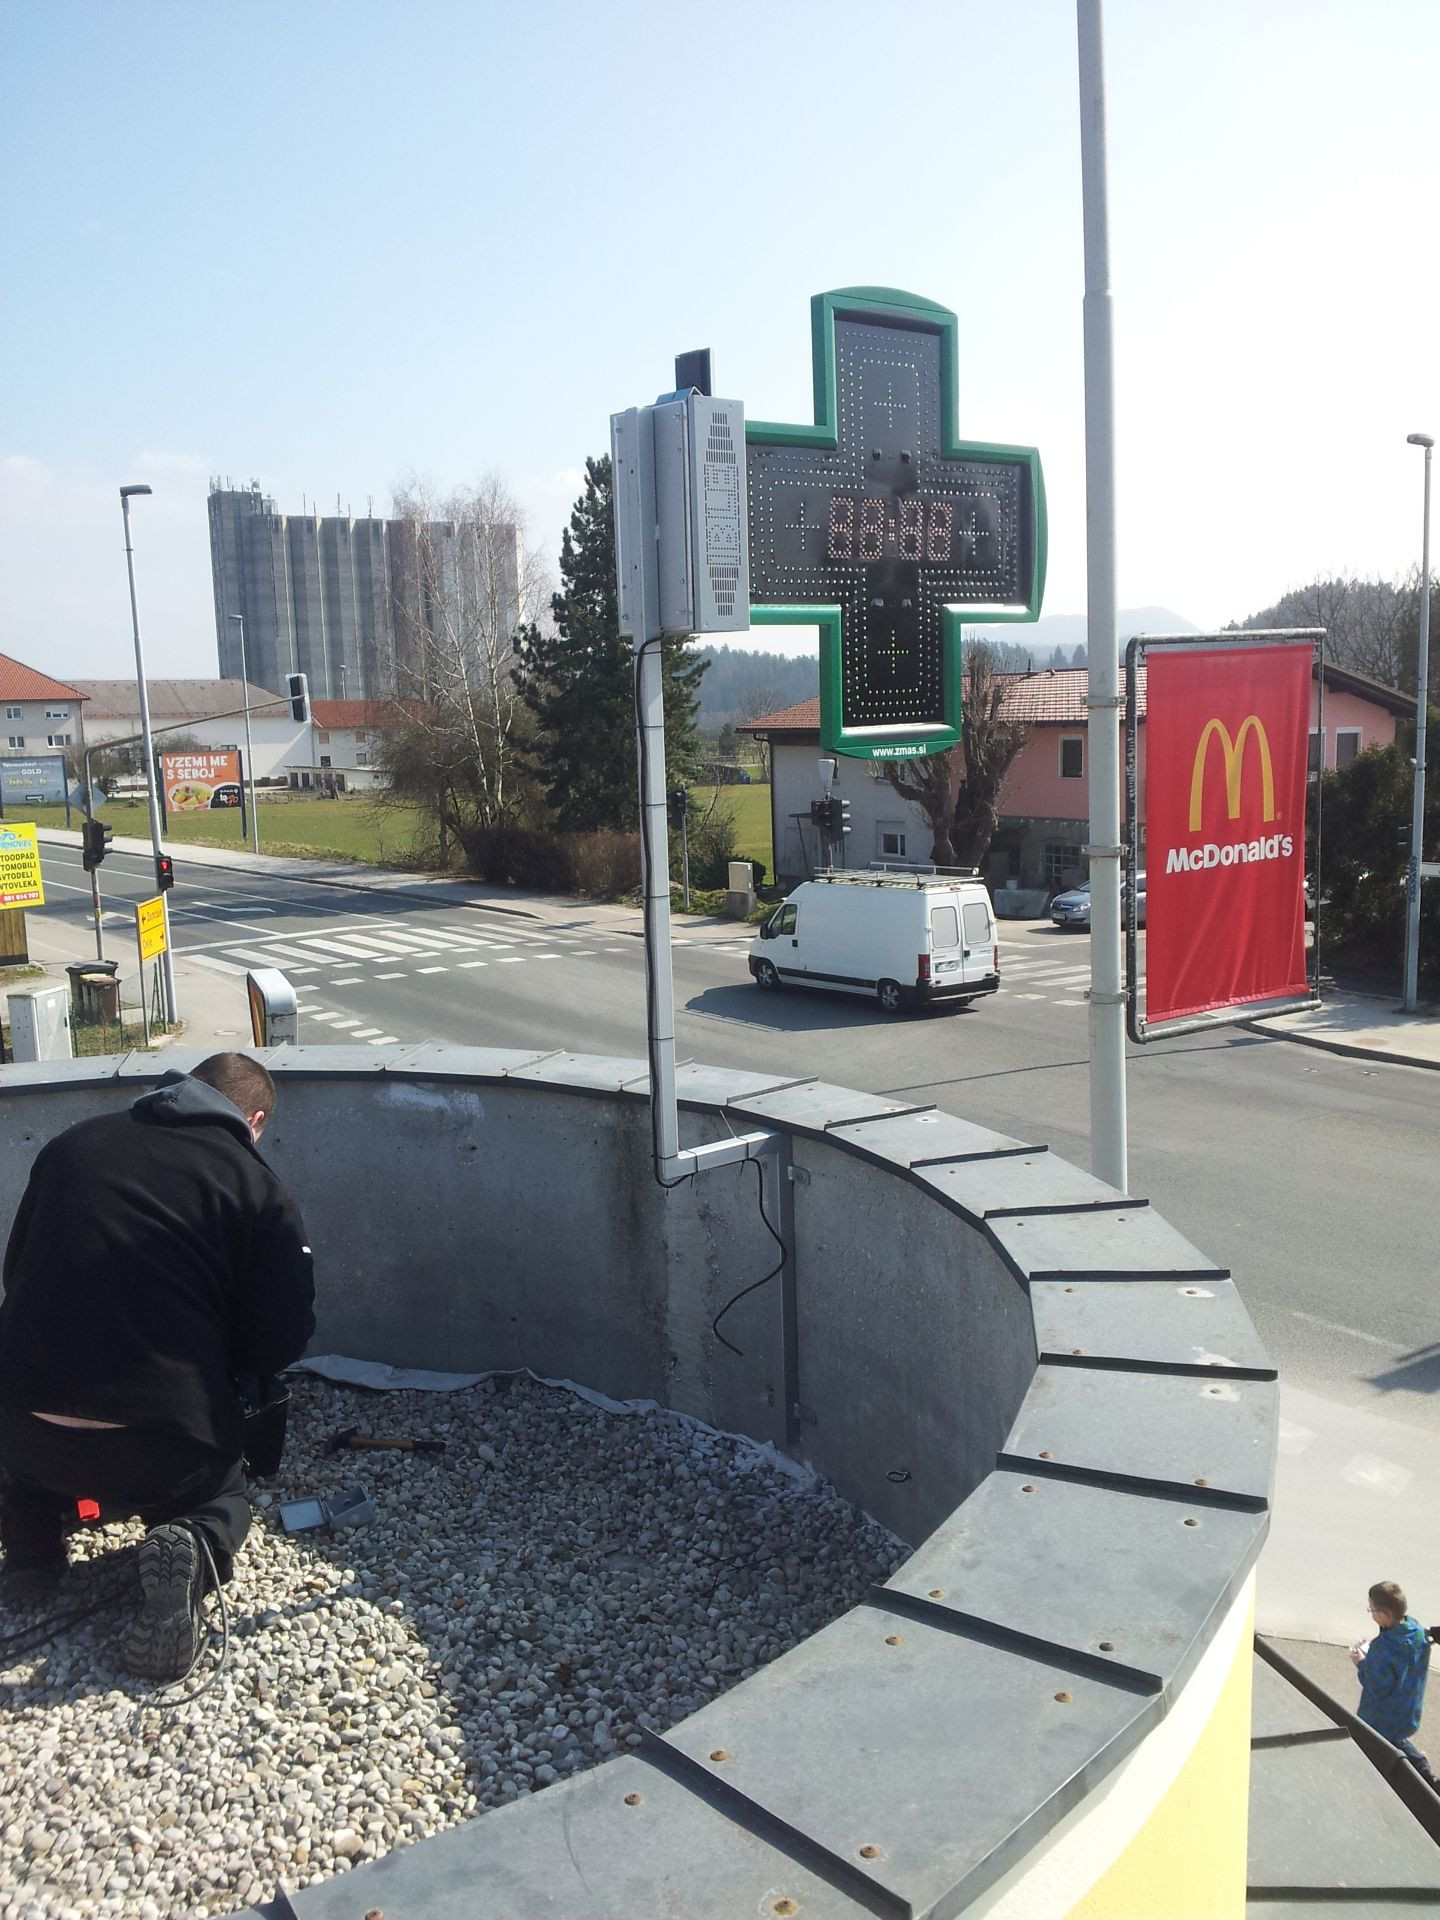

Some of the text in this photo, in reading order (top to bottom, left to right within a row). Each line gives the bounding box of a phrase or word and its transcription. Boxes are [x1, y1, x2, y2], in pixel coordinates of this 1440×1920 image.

[872, 743, 926, 757] www.zmas.si
[166, 755, 228, 768] VZEMI ME
[167, 769, 174, 780] S
[1166, 833, 1293, 874] McDonald's
